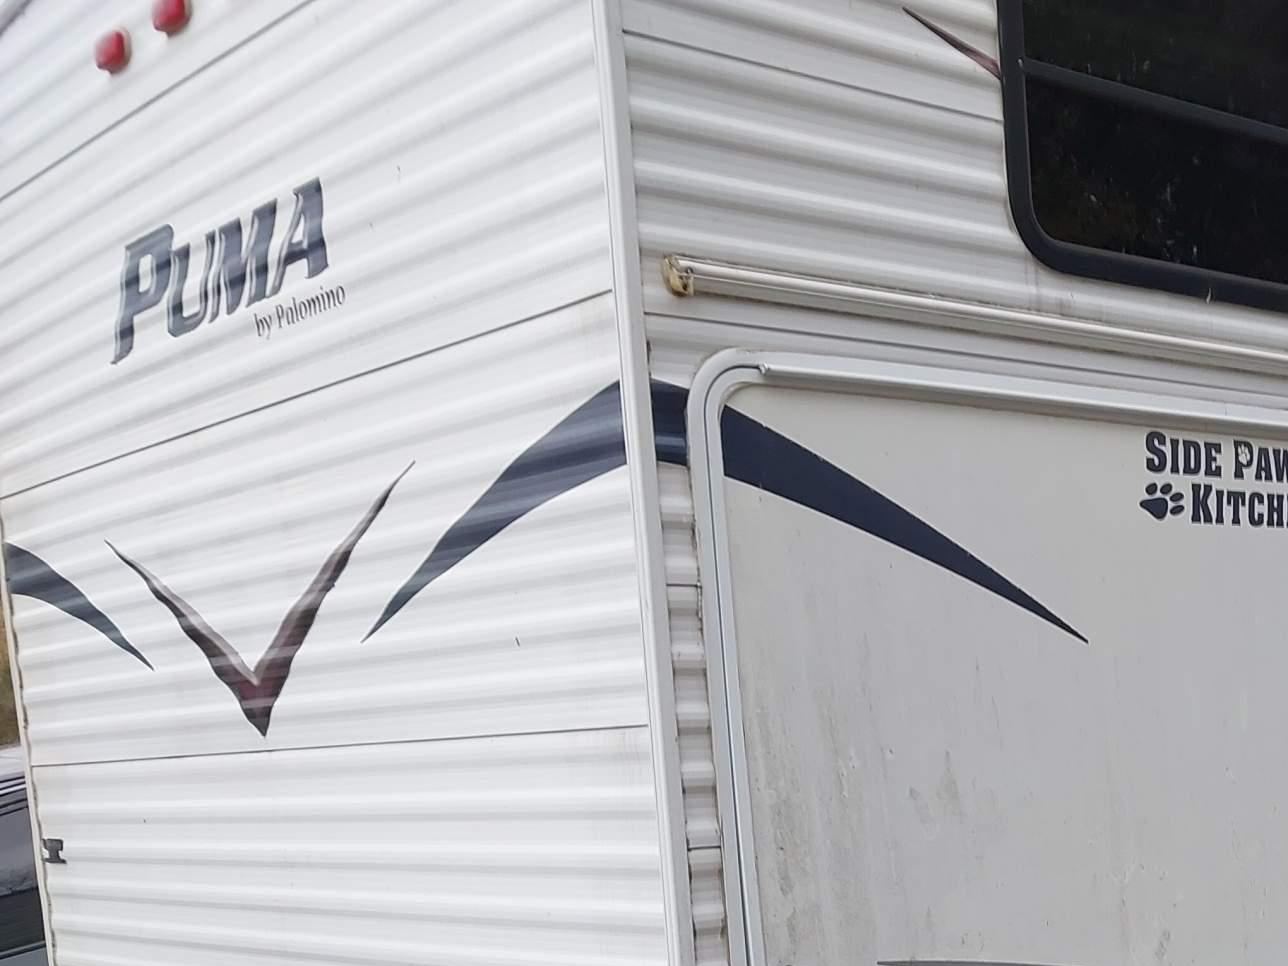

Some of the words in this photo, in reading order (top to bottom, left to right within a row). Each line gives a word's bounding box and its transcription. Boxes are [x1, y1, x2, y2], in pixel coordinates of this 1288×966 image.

[110, 176, 329, 365] PUMA
[254, 313, 273, 339] by
[275, 285, 347, 329] Palomino
[1145, 431, 1222, 478] SIDE
